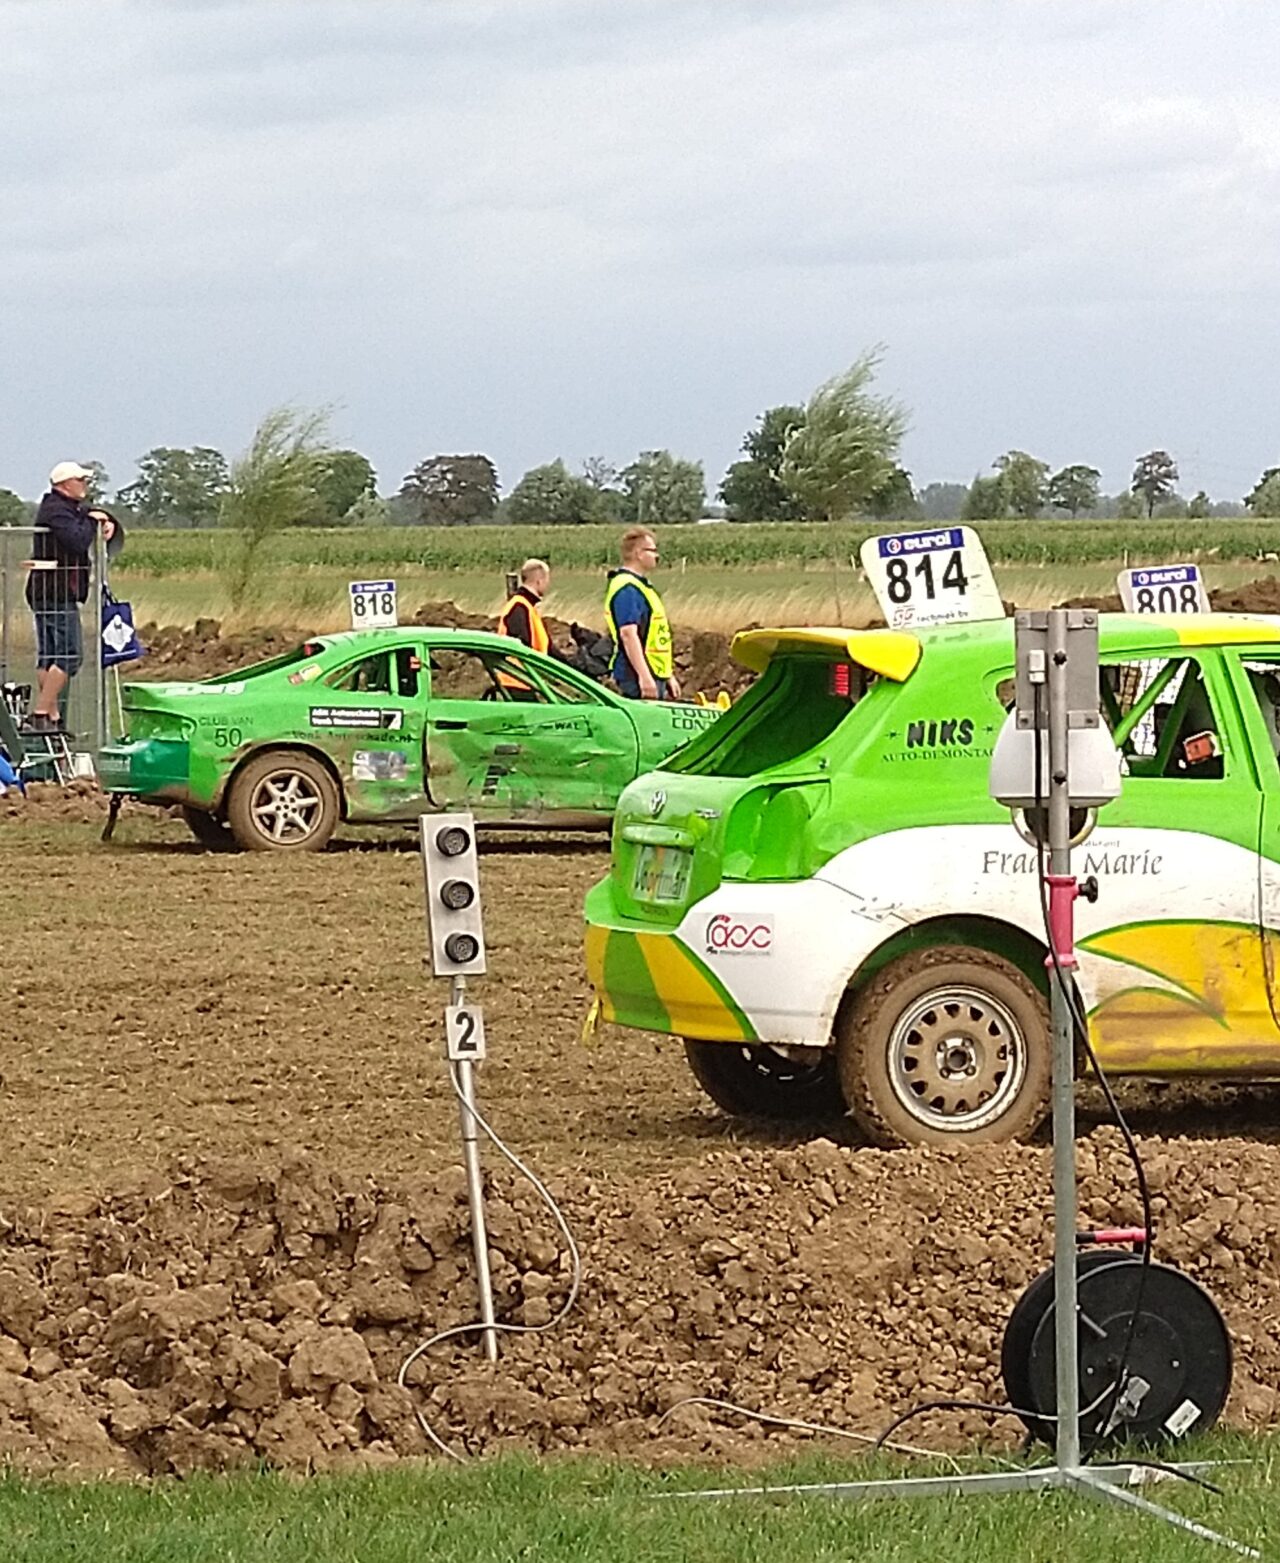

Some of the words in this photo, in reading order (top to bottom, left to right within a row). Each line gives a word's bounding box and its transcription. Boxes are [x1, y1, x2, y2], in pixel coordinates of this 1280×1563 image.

[885, 550, 969, 604] 814
[353, 592, 394, 617] 818
[1136, 584, 1199, 614] 808
[214, 727, 243, 748] 50
[906, 718, 975, 749] NIKS
[1083, 849, 1163, 876] Marie
[455, 1011, 478, 1052] 2
